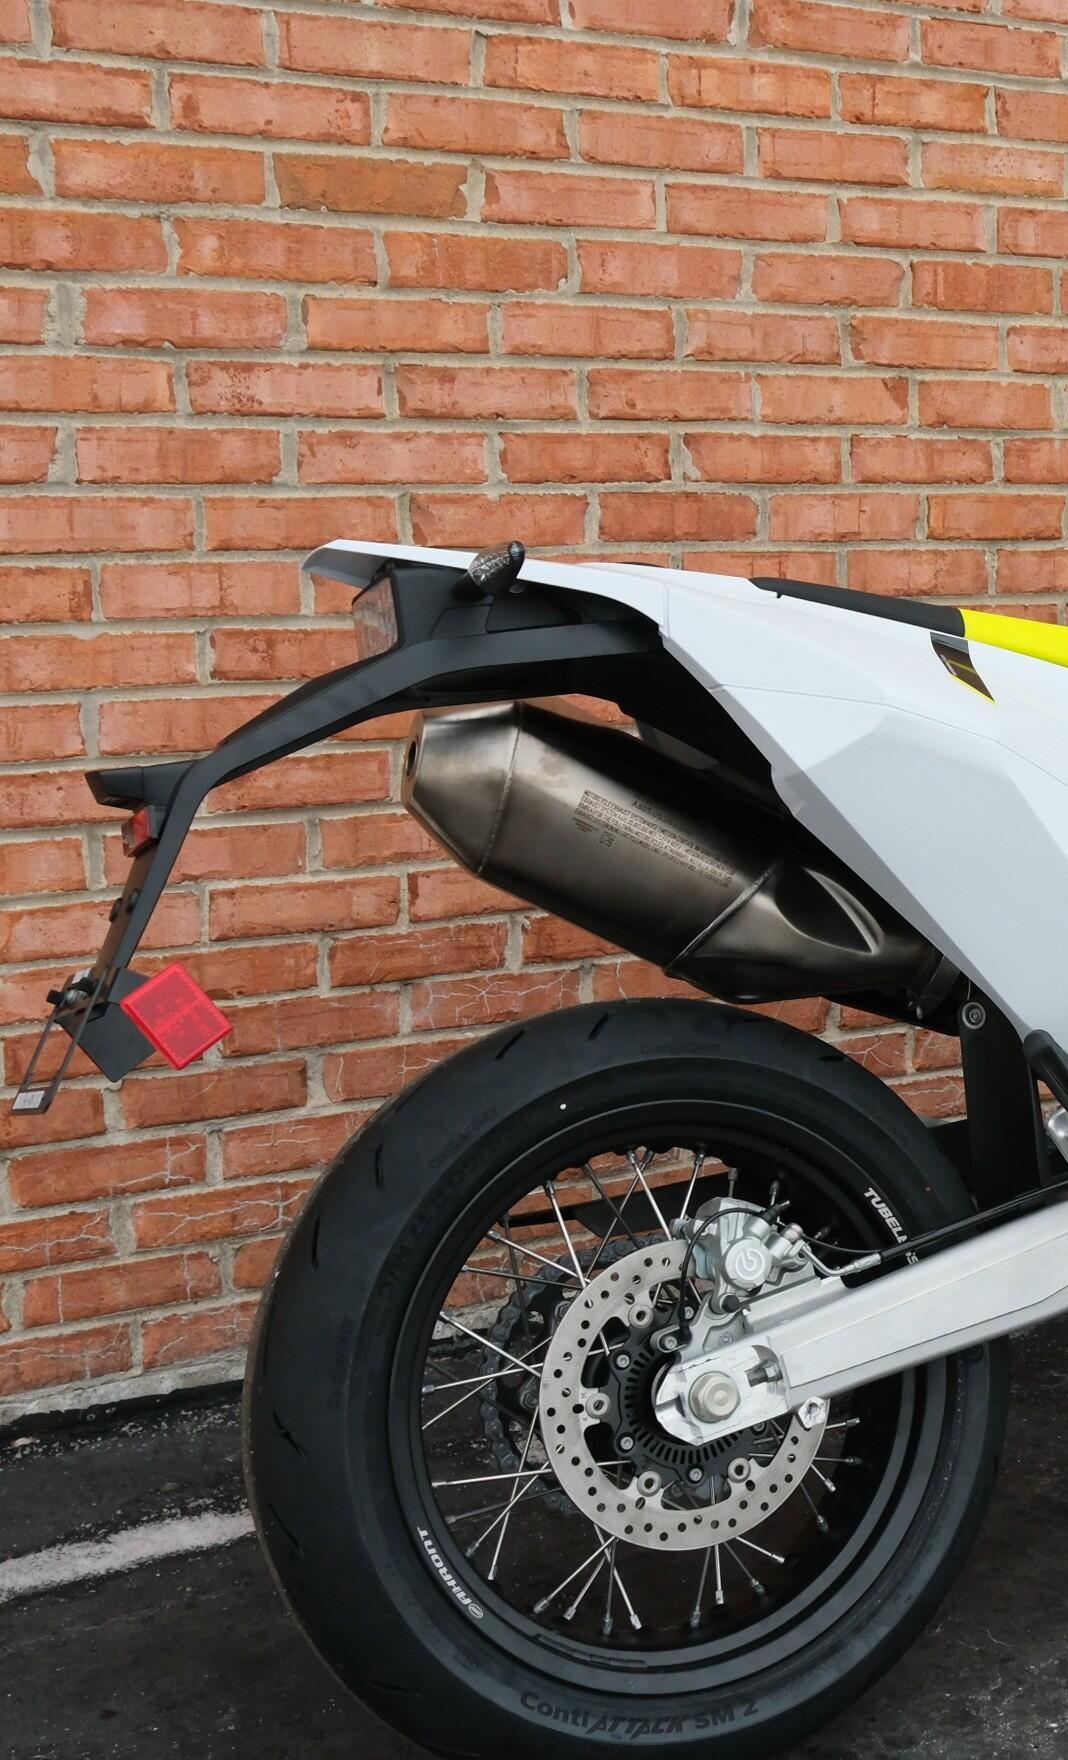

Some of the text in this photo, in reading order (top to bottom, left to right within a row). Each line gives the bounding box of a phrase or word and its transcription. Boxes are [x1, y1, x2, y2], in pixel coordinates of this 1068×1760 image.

[863, 1187, 919, 1264] TUBELS
[694, 1704, 736, 1730] SM
[742, 1700, 760, 1717] 2
